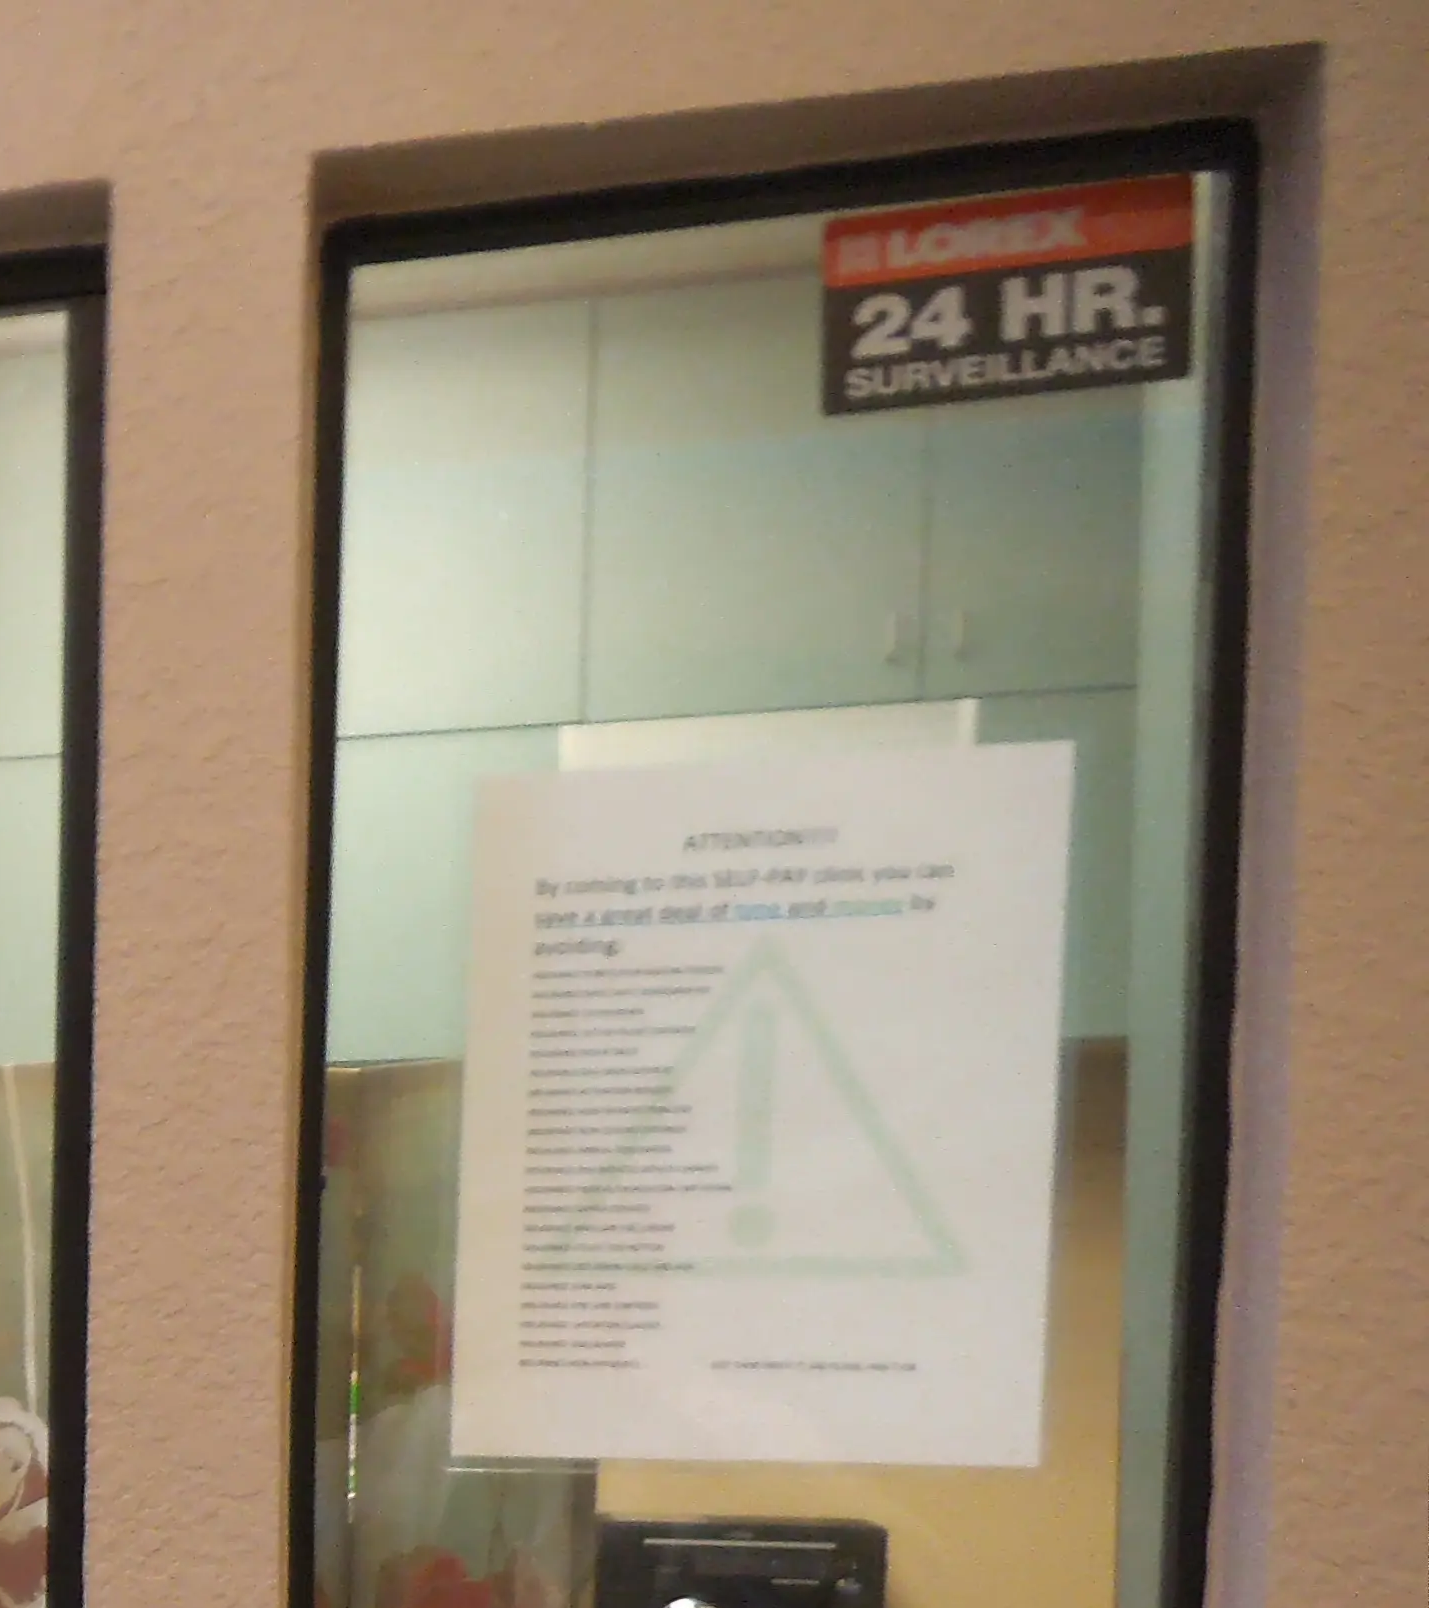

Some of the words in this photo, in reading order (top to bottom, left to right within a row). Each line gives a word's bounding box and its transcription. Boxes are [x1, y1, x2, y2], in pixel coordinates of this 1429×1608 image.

[886, 206, 1087, 268] LOREX
[851, 285, 974, 360] 24
[999, 265, 1167, 342] HR.
[843, 335, 1166, 399] SURVEILLANCE
